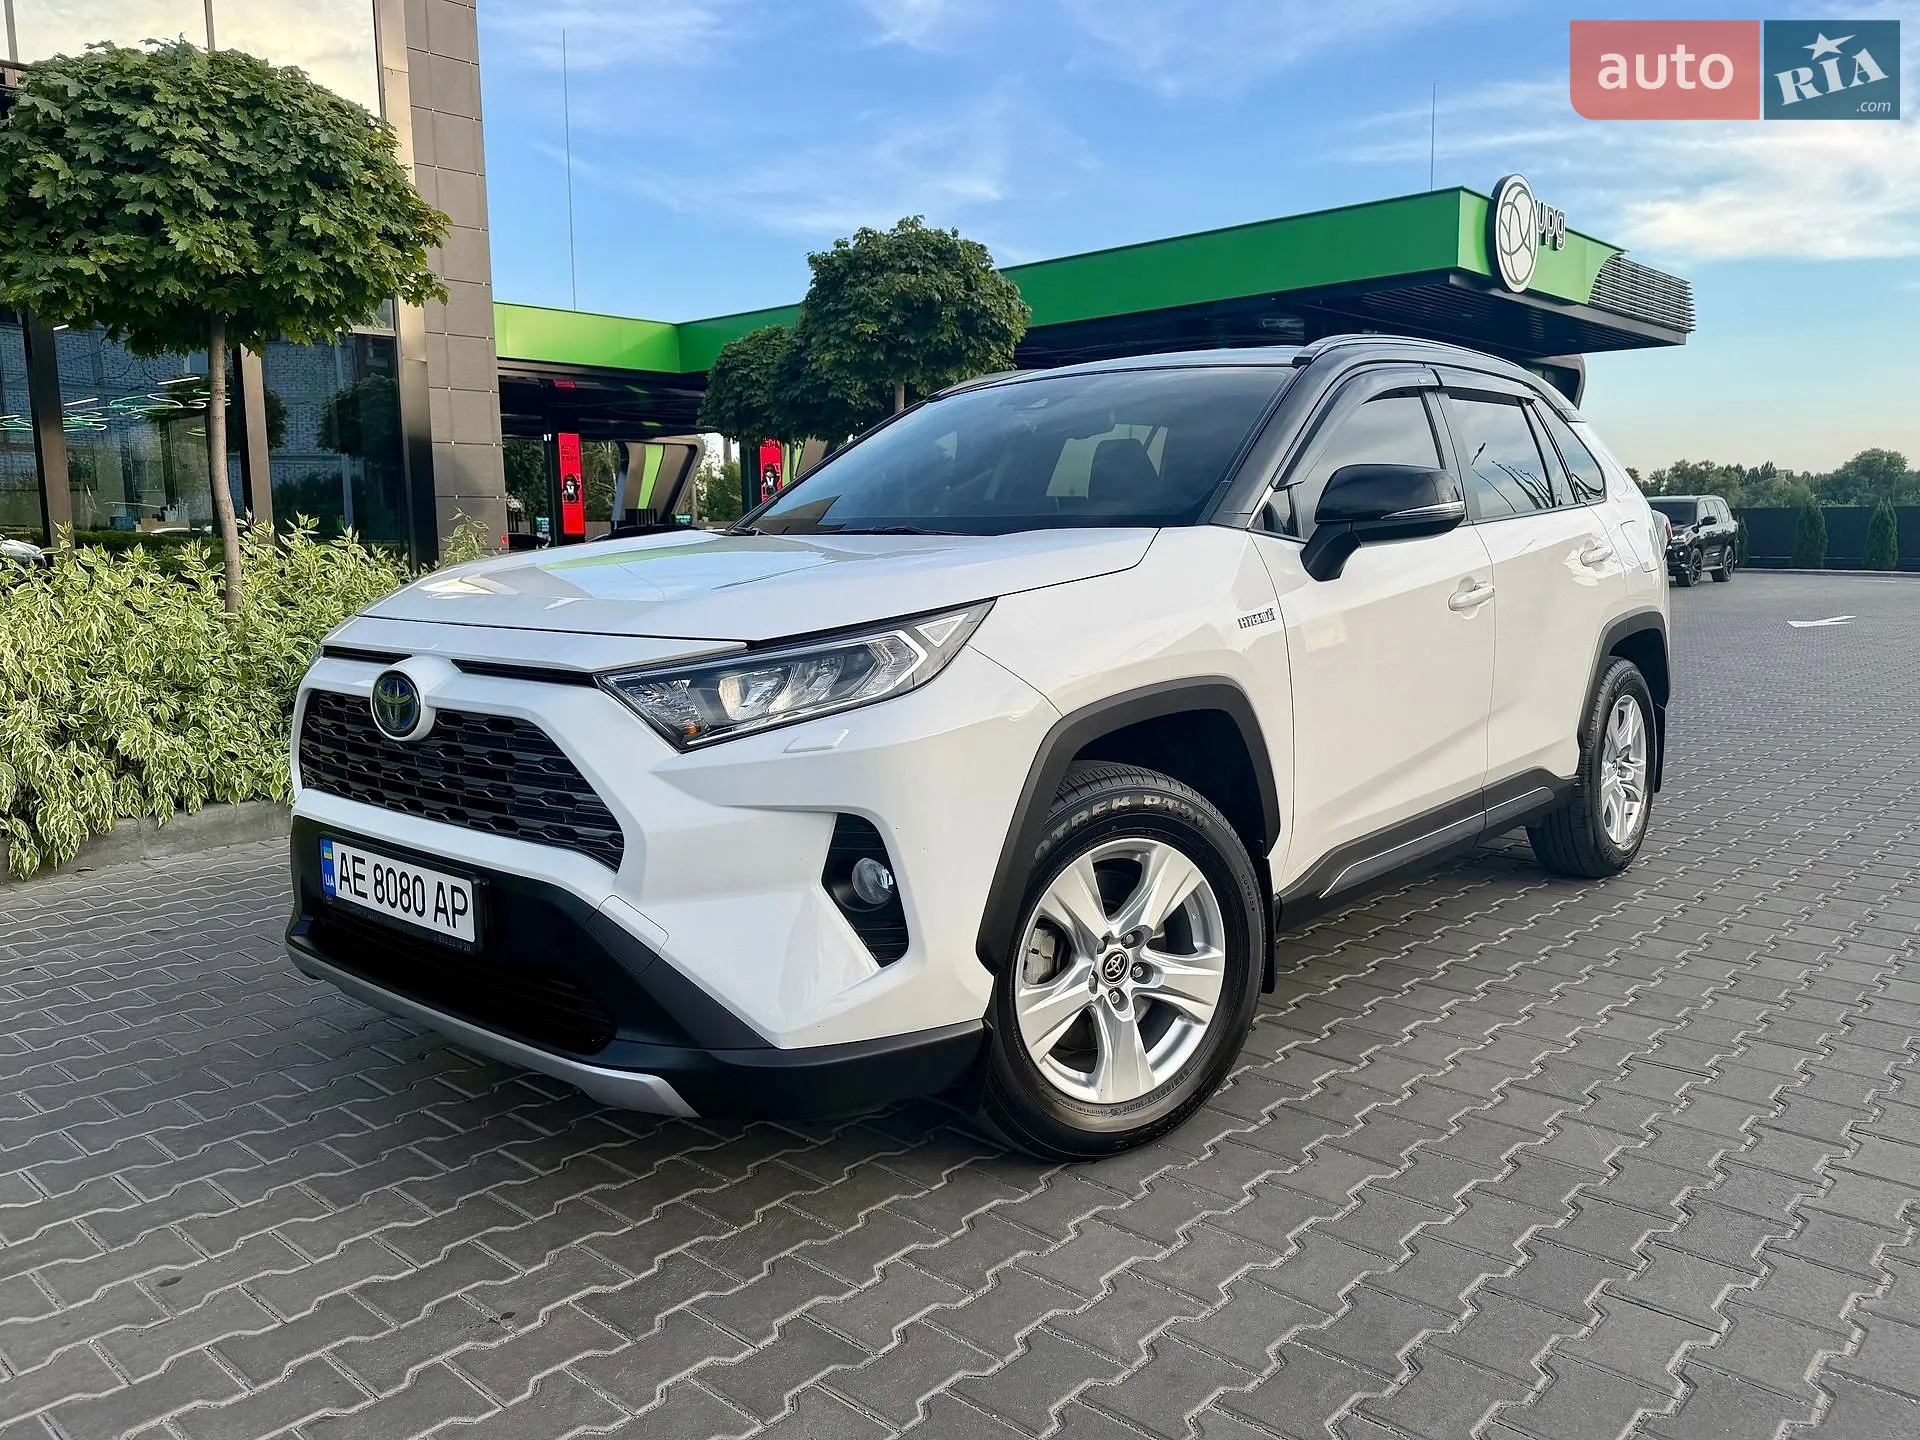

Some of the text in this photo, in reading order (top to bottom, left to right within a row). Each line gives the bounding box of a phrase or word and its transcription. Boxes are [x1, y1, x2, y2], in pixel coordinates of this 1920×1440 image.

[1536, 201, 1566, 249] upg
[325, 873, 335, 887] UA
[339, 852, 368, 899] AE
[374, 863, 425, 917] 8080
[434, 881, 468, 929] AP
